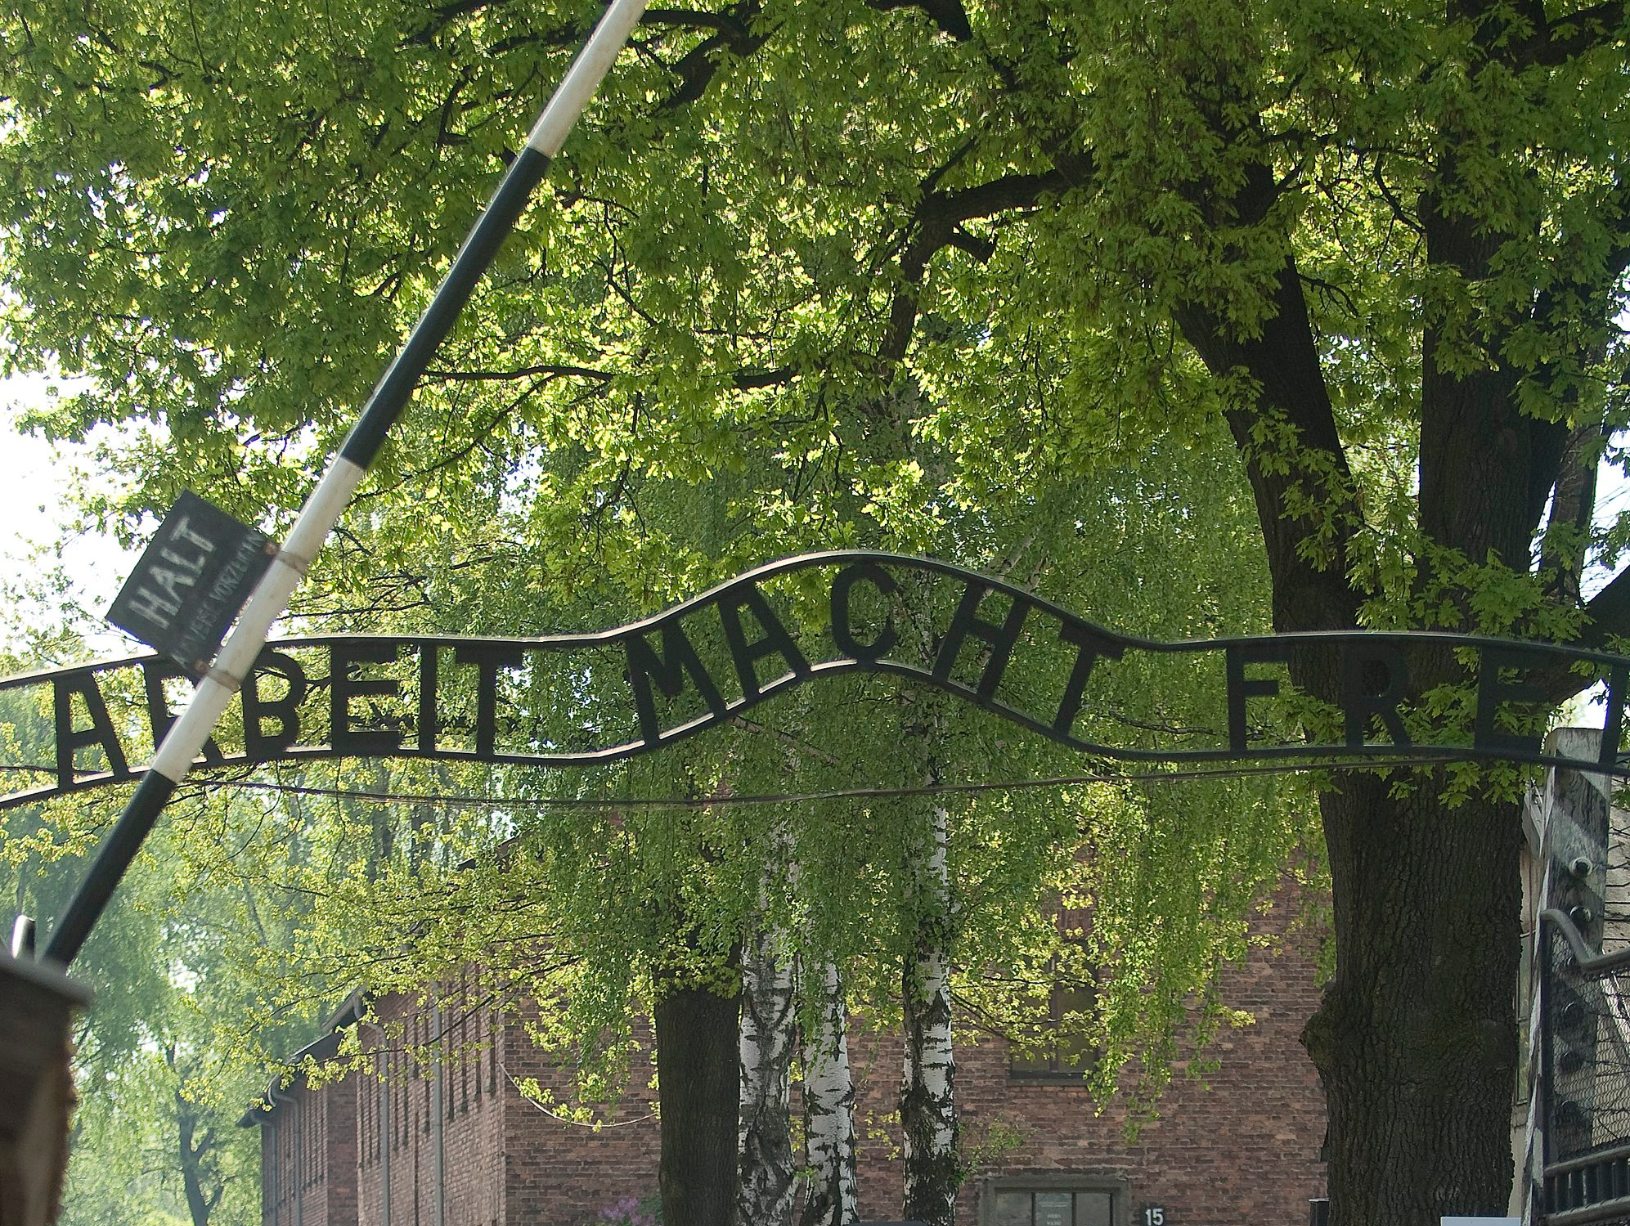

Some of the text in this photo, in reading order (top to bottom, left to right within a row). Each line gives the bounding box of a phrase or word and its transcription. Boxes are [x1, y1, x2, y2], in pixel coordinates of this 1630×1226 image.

[128, 515, 215, 630] HALT
[625, 564, 1123, 744] MACHT
[1228, 645, 1628, 766] FREI
[1145, 1208, 1164, 1226] 15
